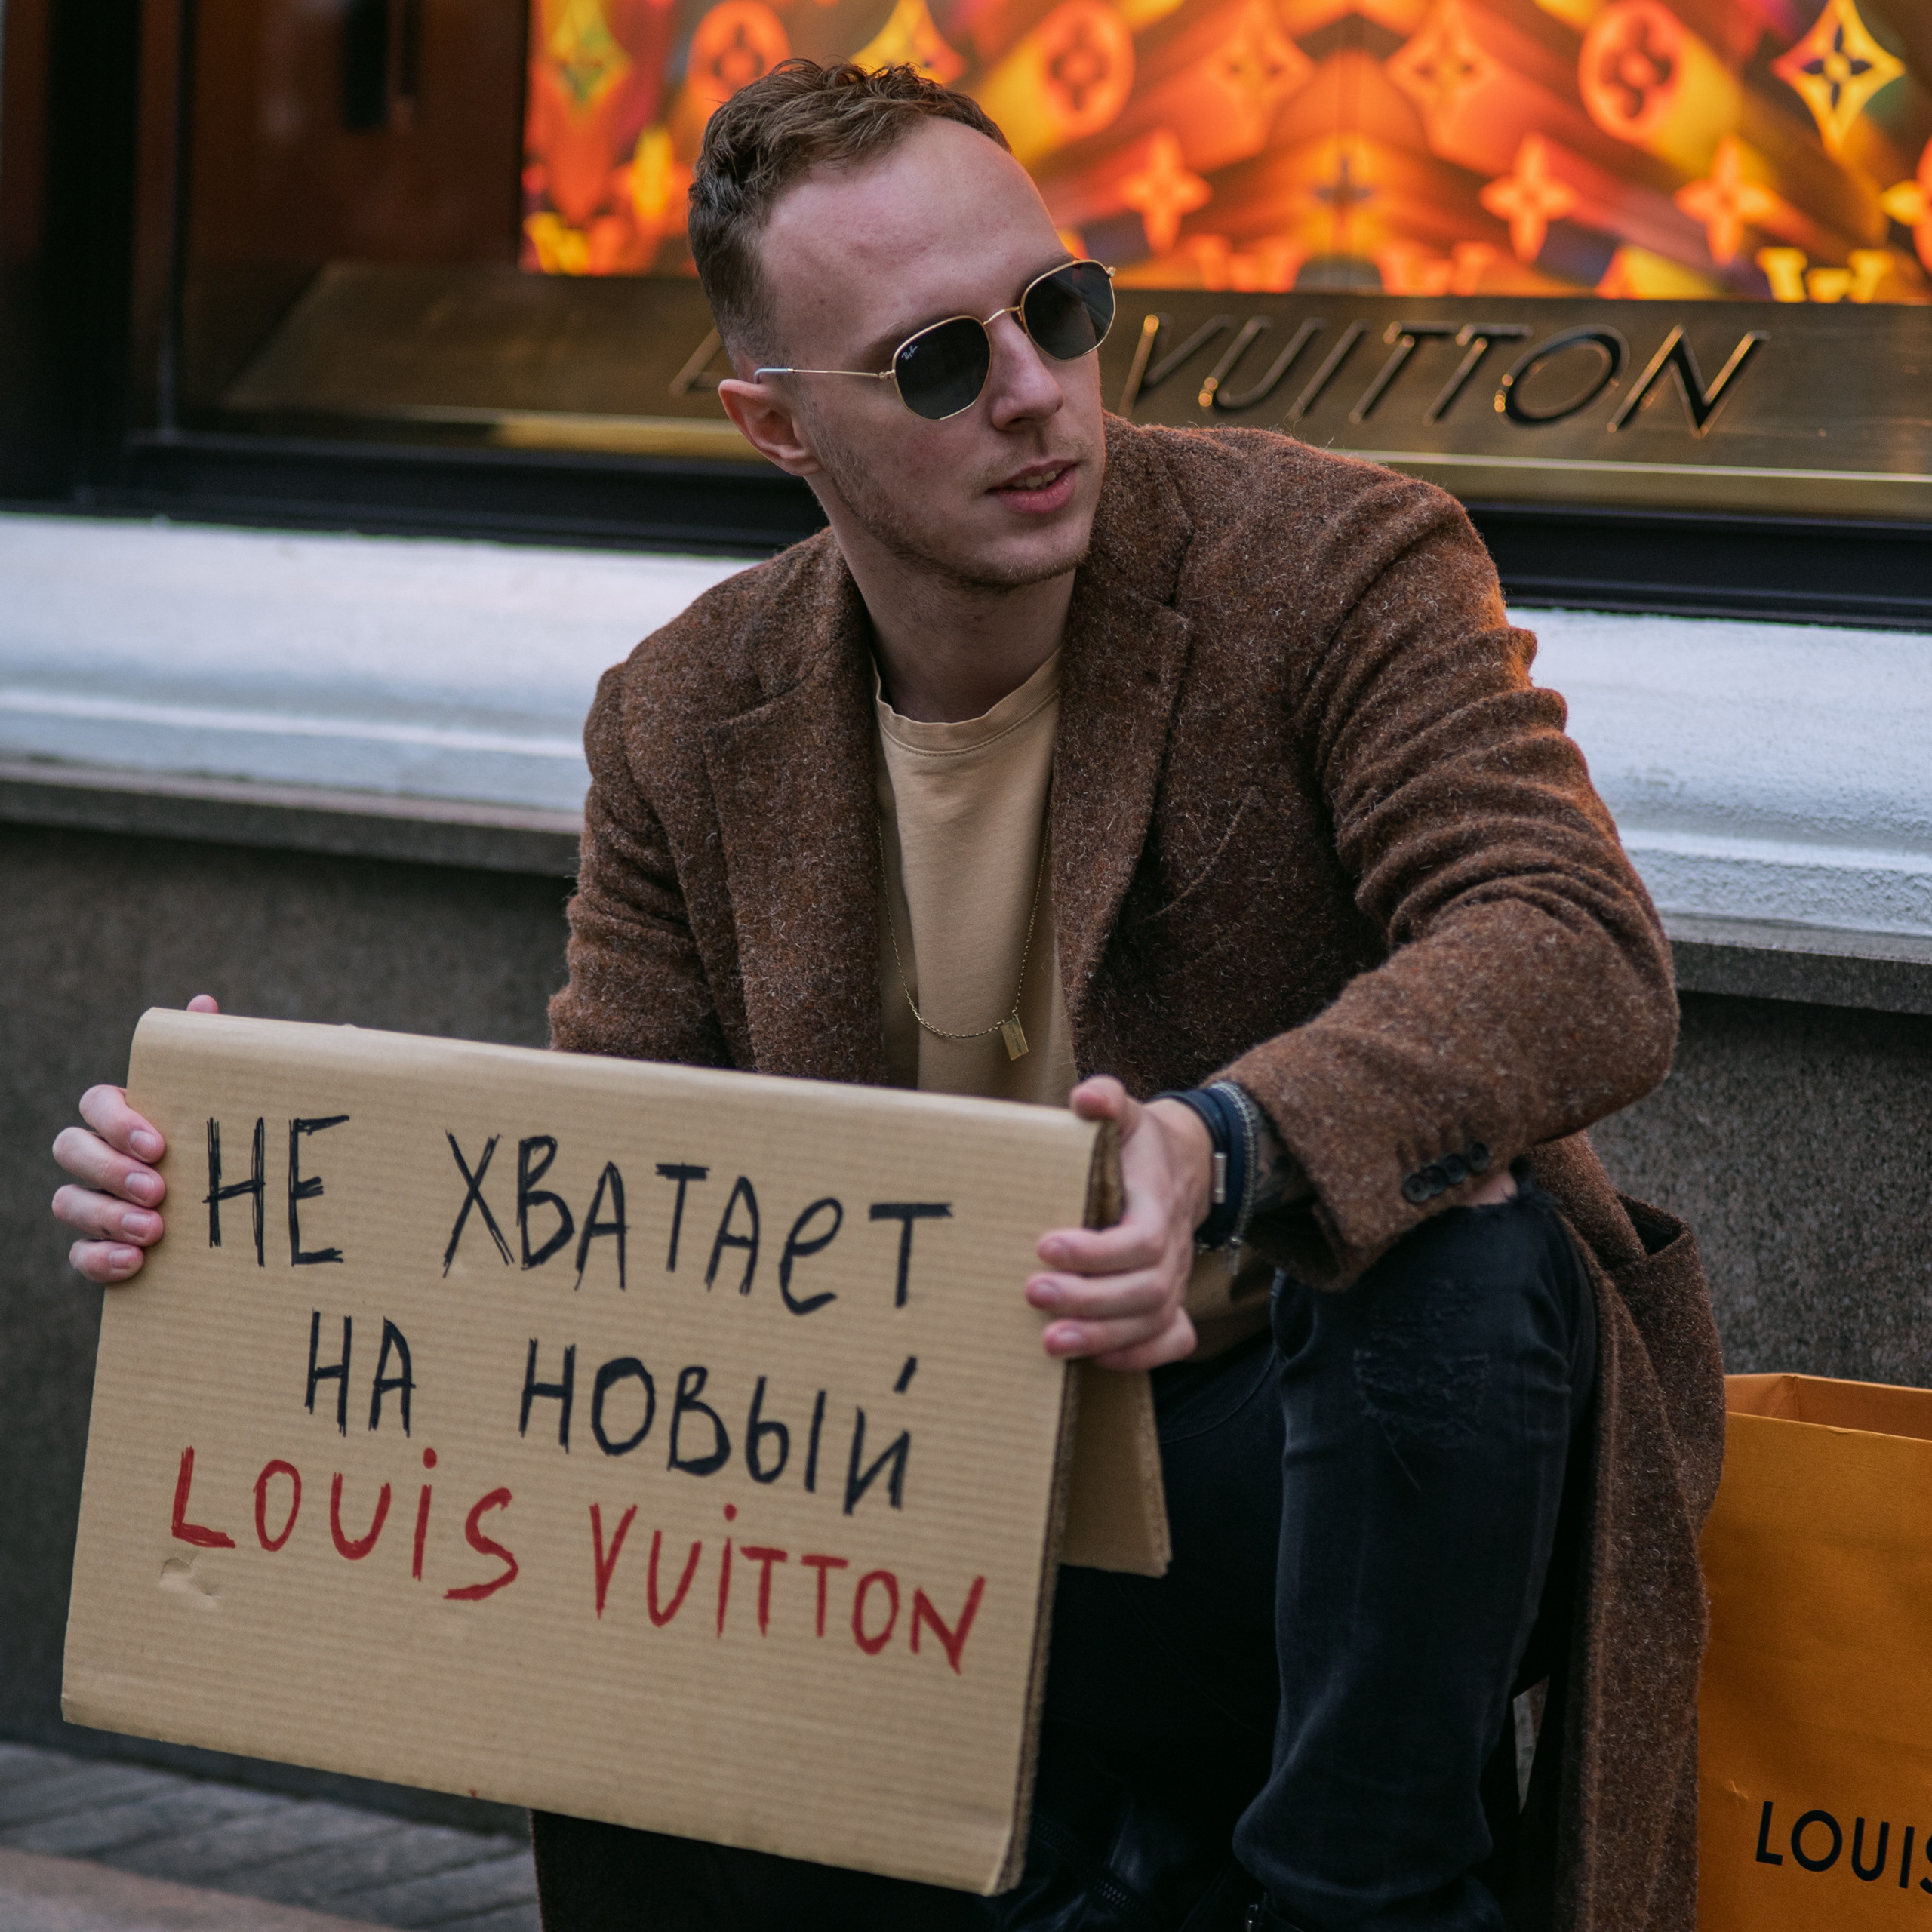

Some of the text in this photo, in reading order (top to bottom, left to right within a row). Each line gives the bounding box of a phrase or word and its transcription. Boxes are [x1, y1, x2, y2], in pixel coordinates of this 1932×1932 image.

[1118, 313, 1772, 439] VUITTON
[202, 1115, 350, 1267] НЕ
[304, 1308, 918, 1515] НА НОВЫЙ
